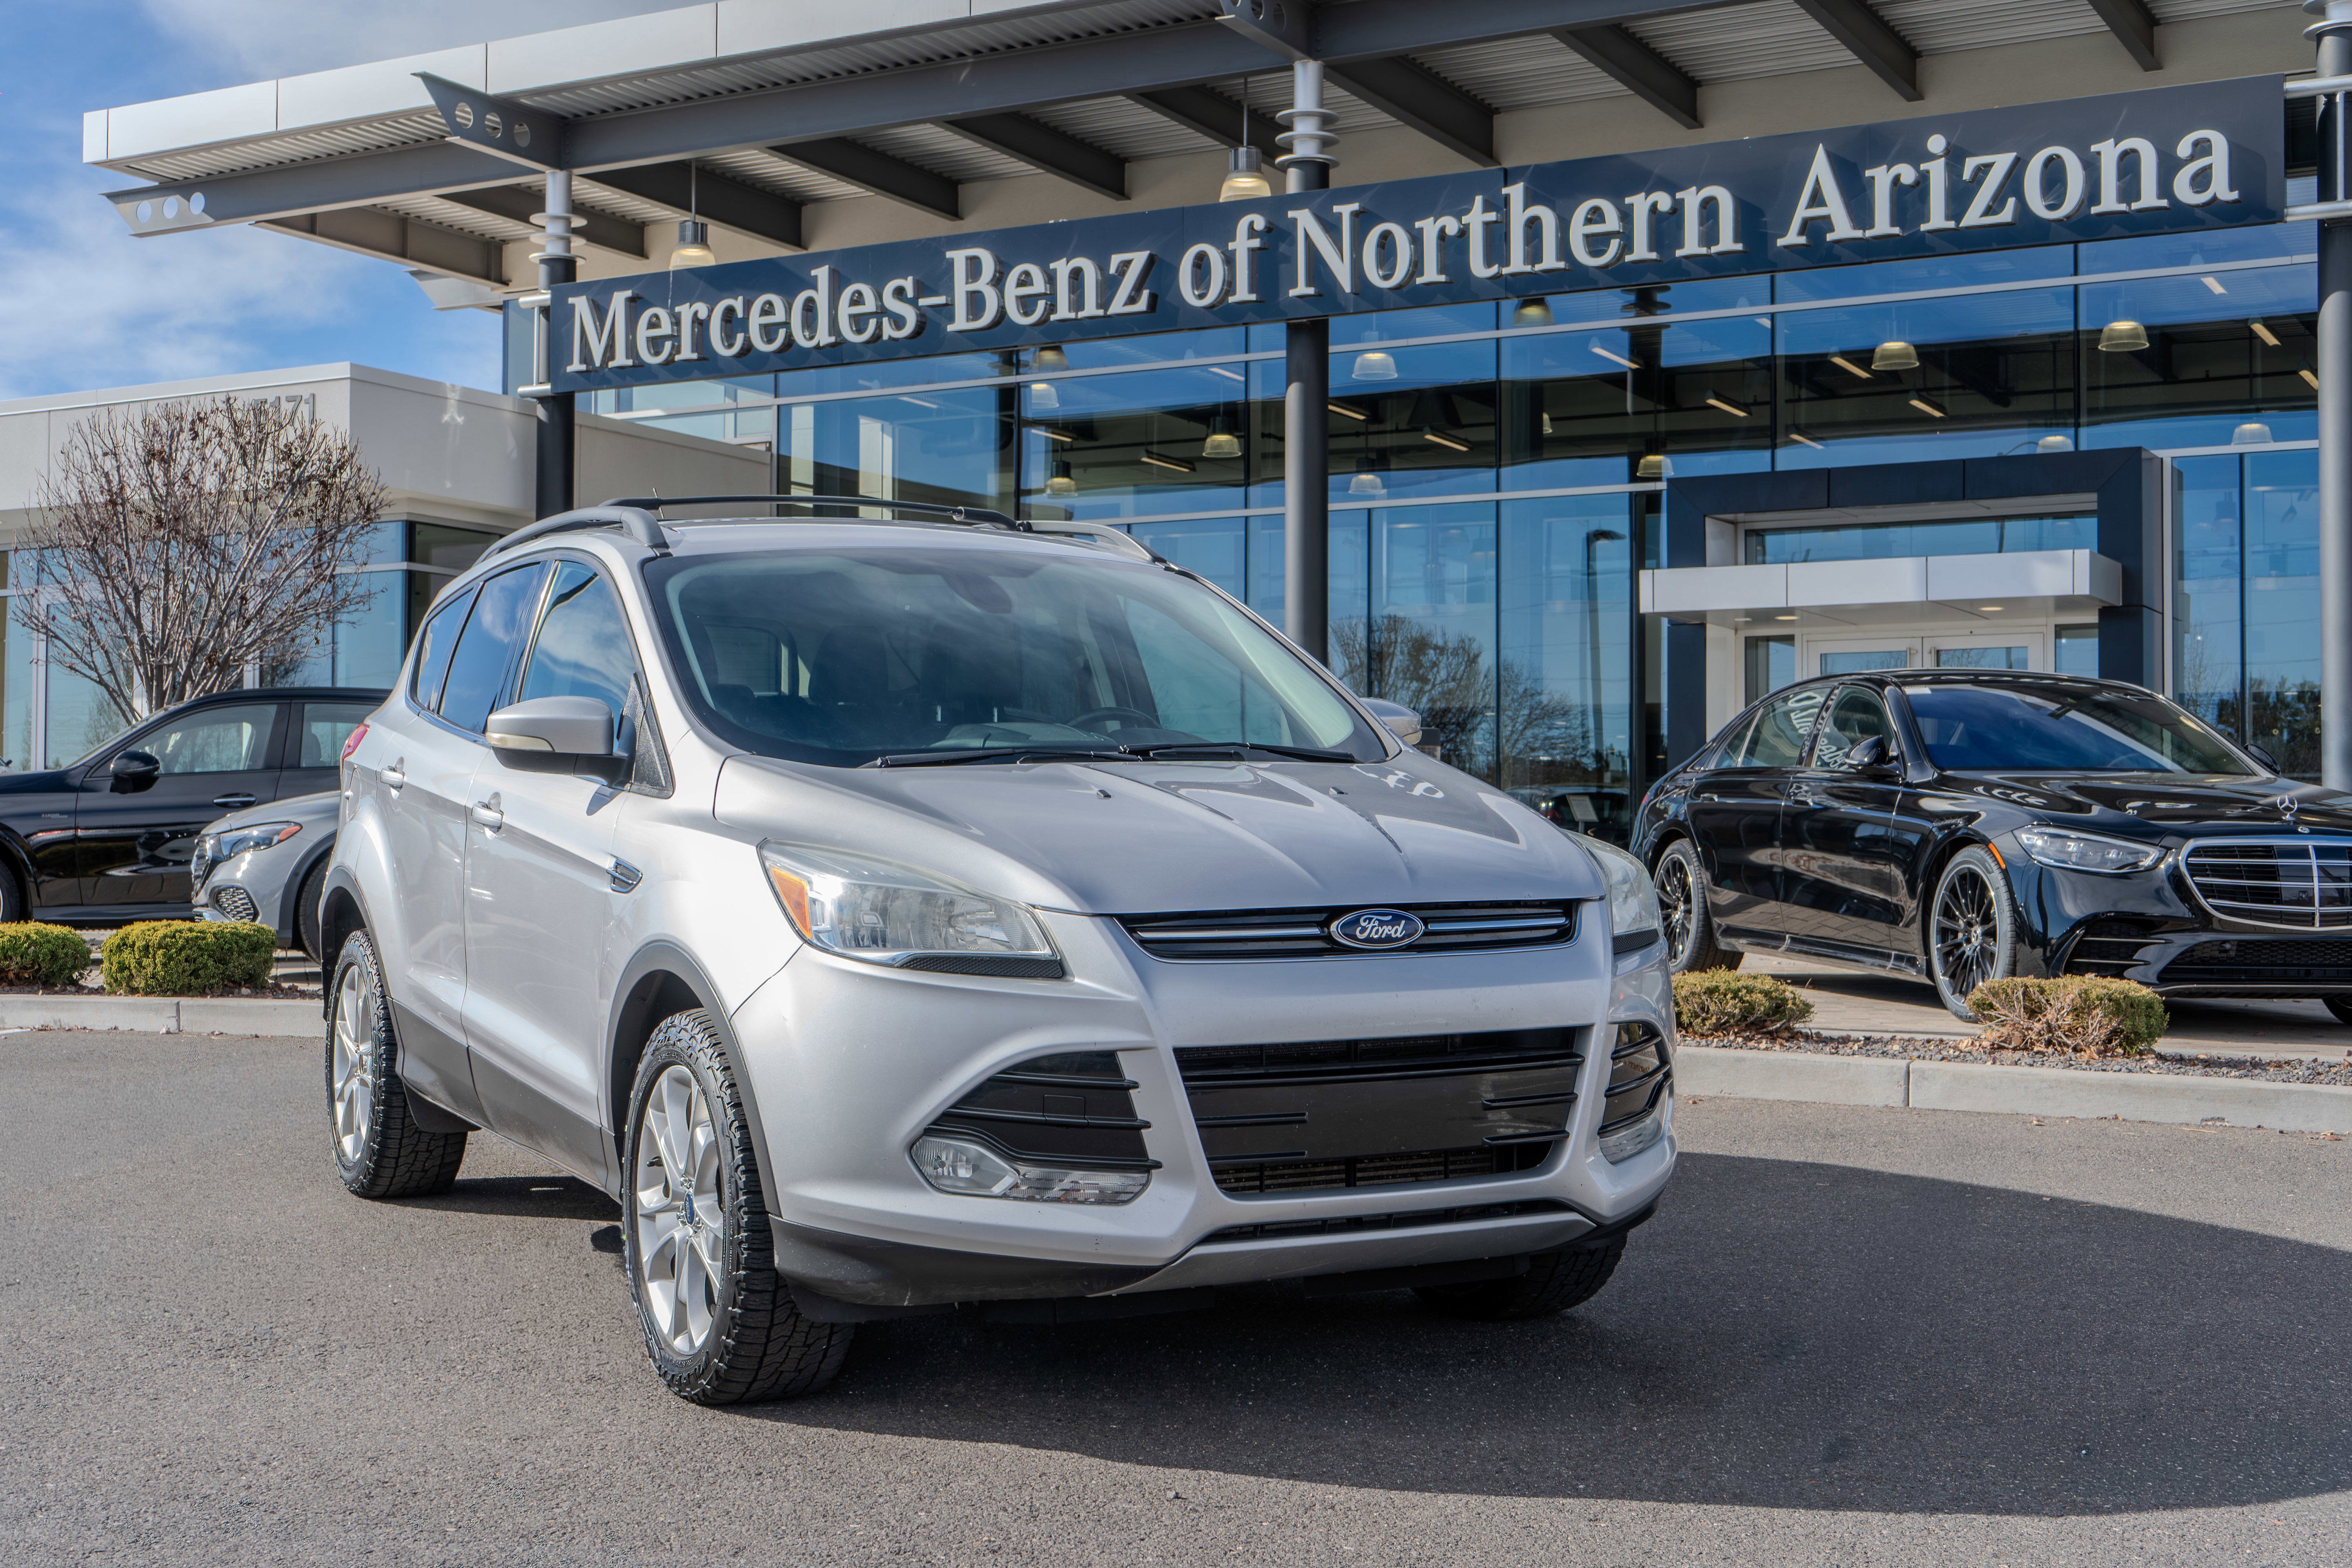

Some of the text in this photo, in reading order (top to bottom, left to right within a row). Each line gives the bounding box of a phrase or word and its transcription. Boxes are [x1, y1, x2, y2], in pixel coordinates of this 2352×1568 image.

[566, 129, 2240, 372] Mercedes-Benz of Northern Arizona
[254, 393, 316, 429] 171
[1356, 915, 1405, 939] Ford
